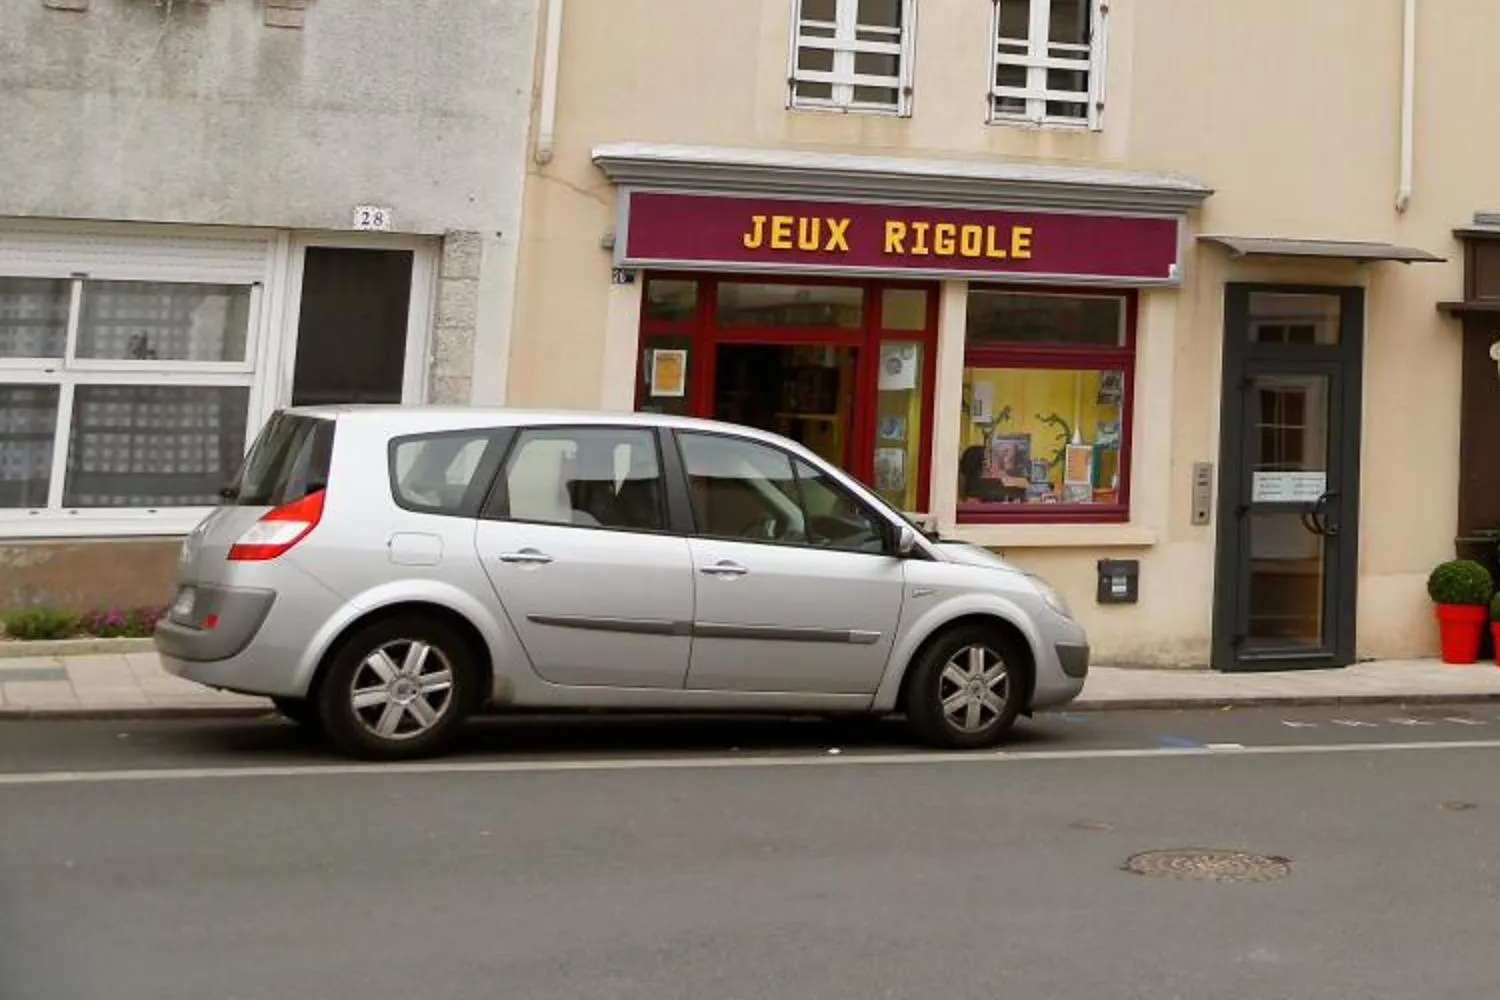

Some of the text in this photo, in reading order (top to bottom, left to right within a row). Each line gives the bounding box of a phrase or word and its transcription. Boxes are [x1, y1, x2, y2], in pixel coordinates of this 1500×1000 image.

[361, 210, 384, 227] 28
[743, 214, 1034, 259] JEUX RIGOLE
